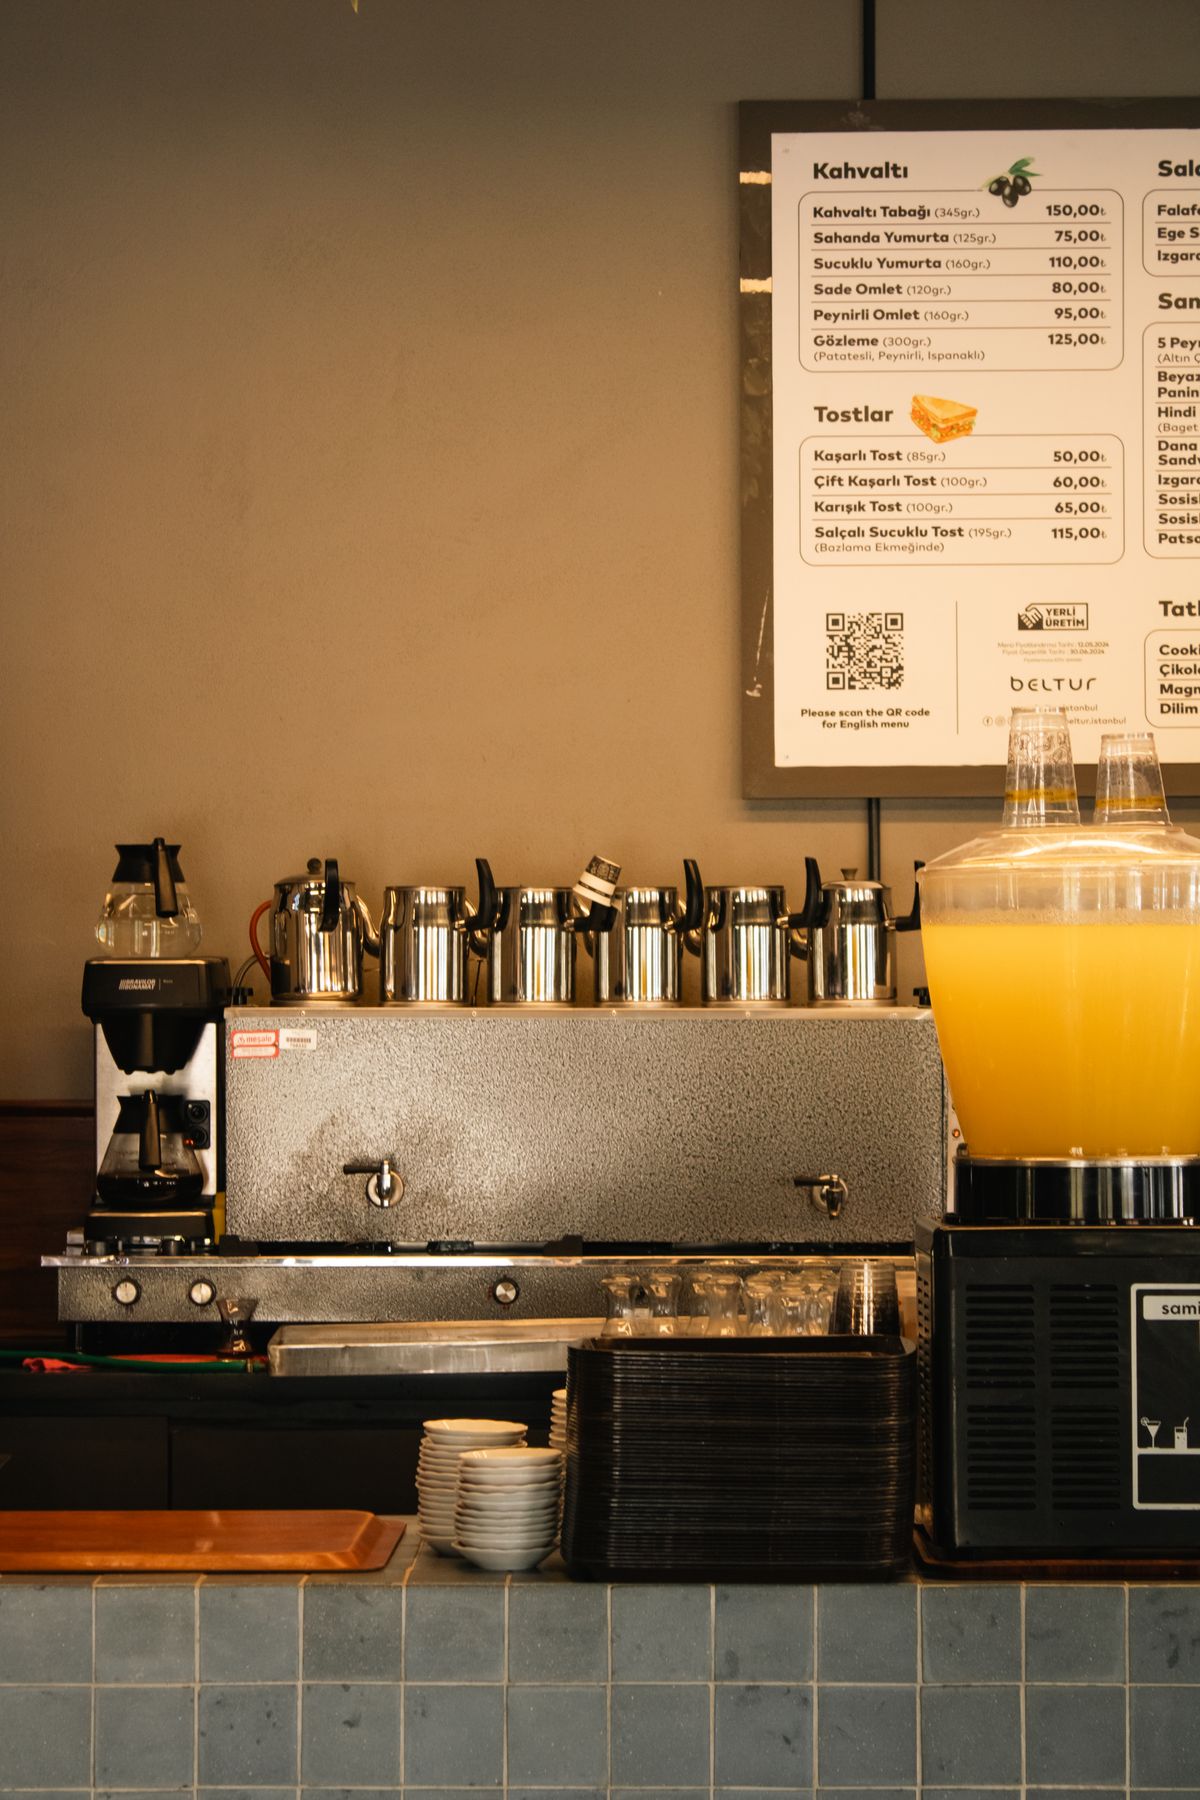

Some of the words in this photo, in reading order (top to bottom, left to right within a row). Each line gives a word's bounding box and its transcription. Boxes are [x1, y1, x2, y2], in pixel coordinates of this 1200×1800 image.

[813, 161, 908, 180] Kahvaltı
[813, 206, 877, 218] Kahvaltı
[880, 205, 931, 220] Tabağı
[935, 208, 980, 220] (345gr.)
[1157, 204, 1200, 216] Falaf
[813, 231, 880, 244] Sahanda
[884, 231, 949, 243] Yumurta
[953, 233, 996, 245] (125gr.)
[1157, 227, 1186, 242] Ege
[814, 257, 873, 270] Sucuklu
[876, 257, 942, 269] Yumurta
[945, 259, 990, 271] (160gr.)
[814, 283, 852, 295] Sade
[855, 283, 903, 295] Omlet
[907, 285, 951, 297] (120gr.)
[814, 308, 869, 324] Peynirli
[873, 308, 920, 320] Omlet
[924, 311, 969, 322] (160gr.)
[813, 334, 879, 347] Gözleme
[883, 337, 931, 349] (300gr.)
[1157, 337, 1166, 349] 5
[1170, 337, 1200, 352] Pey
[814, 351, 874, 362] (Patatesli,
[879, 350, 924, 362] Peynirli,
[928, 350, 985, 362] Ispanaklı)
[1157, 351, 1192, 364] (Altın
[813, 405, 894, 423] Tostlar
[1157, 405, 1196, 418] Hindi
[1158, 440, 1198, 452] Dana
[814, 449, 866, 464] Kaşarlı
[869, 449, 903, 461] Tost
[907, 452, 946, 463] (85gr.)
[814, 475, 844, 490] Çift
[848, 475, 900, 489] Kaşarlı
[903, 475, 937, 486] Tost
[941, 477, 987, 488] (100gr.)
[814, 500, 866, 515] Karışık
[869, 501, 903, 512] Tost
[906, 503, 953, 514] (100gr.)
[815, 526, 865, 540] Salçalı
[869, 526, 928, 538] Sucuklu
[931, 526, 964, 538] Tost
[968, 528, 1011, 540] (195gr.)
[815, 543, 871, 553] (Bazlama
[875, 542, 944, 554] Ekmeğinde)
[1046, 605, 1075, 617] YERLİ
[1045, 616, 1086, 629] ÜRETİM
[1159, 663, 1200, 678] Çikol
[801, 708, 836, 717] Please
[865, 708, 884, 717] the
[886, 708, 902, 717] QR
[905, 707, 930, 717] code
[1160, 702, 1198, 714] Dilim
[822, 719, 837, 728] for
[840, 719, 878, 731] English
